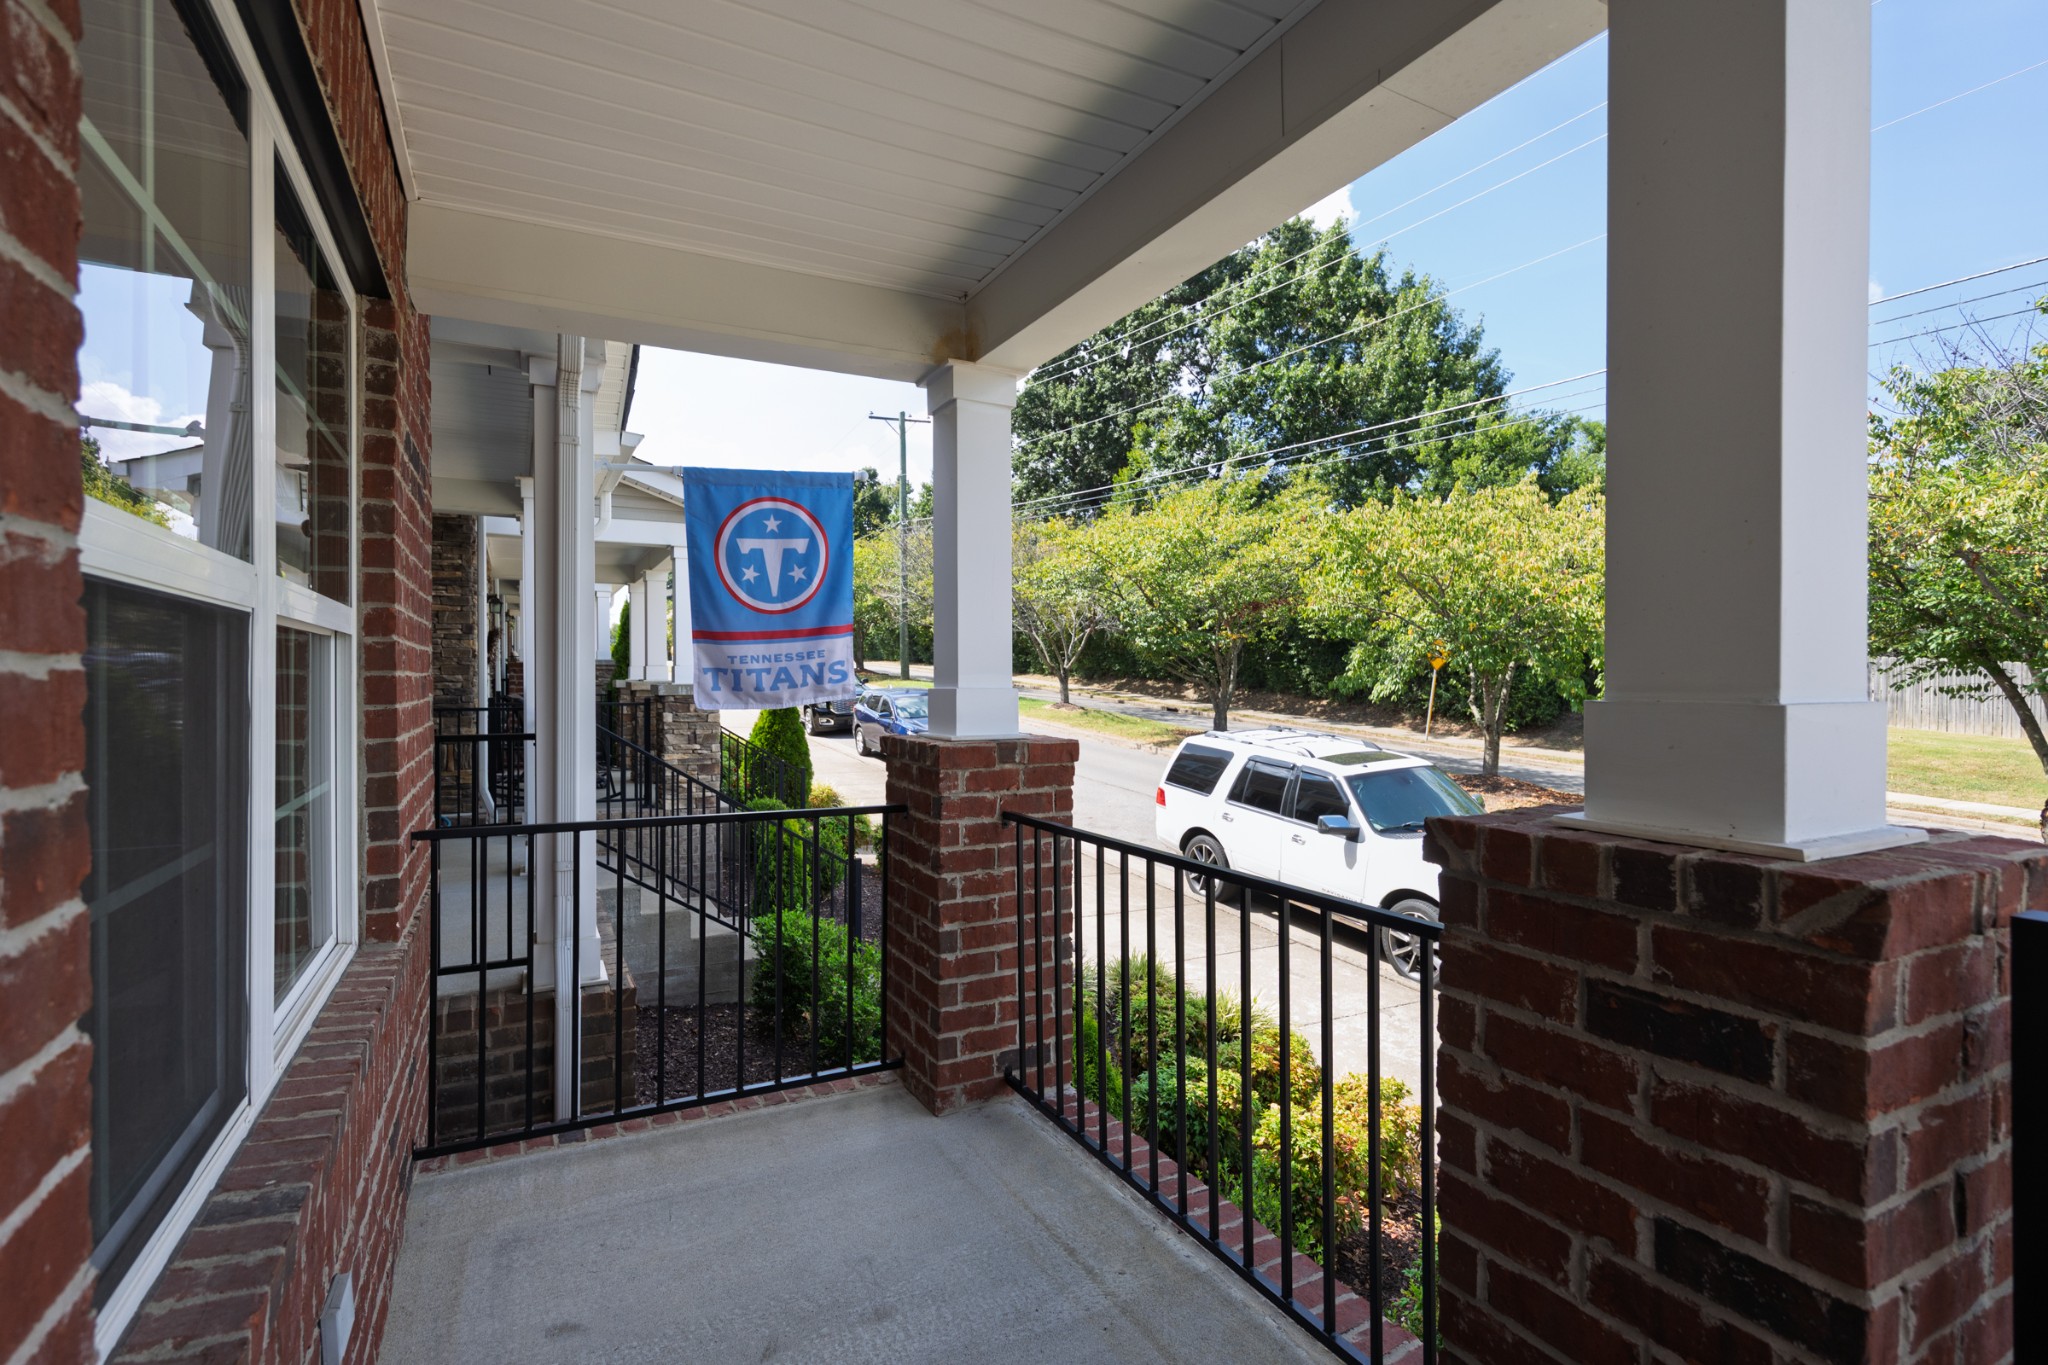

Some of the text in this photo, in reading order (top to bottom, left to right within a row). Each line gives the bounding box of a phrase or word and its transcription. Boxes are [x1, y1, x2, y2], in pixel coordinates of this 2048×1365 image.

[727, 649, 826, 665] TENNESSEE
[703, 659, 849, 692] TITANS
[1321, 887, 1357, 902] NAVIGAT
